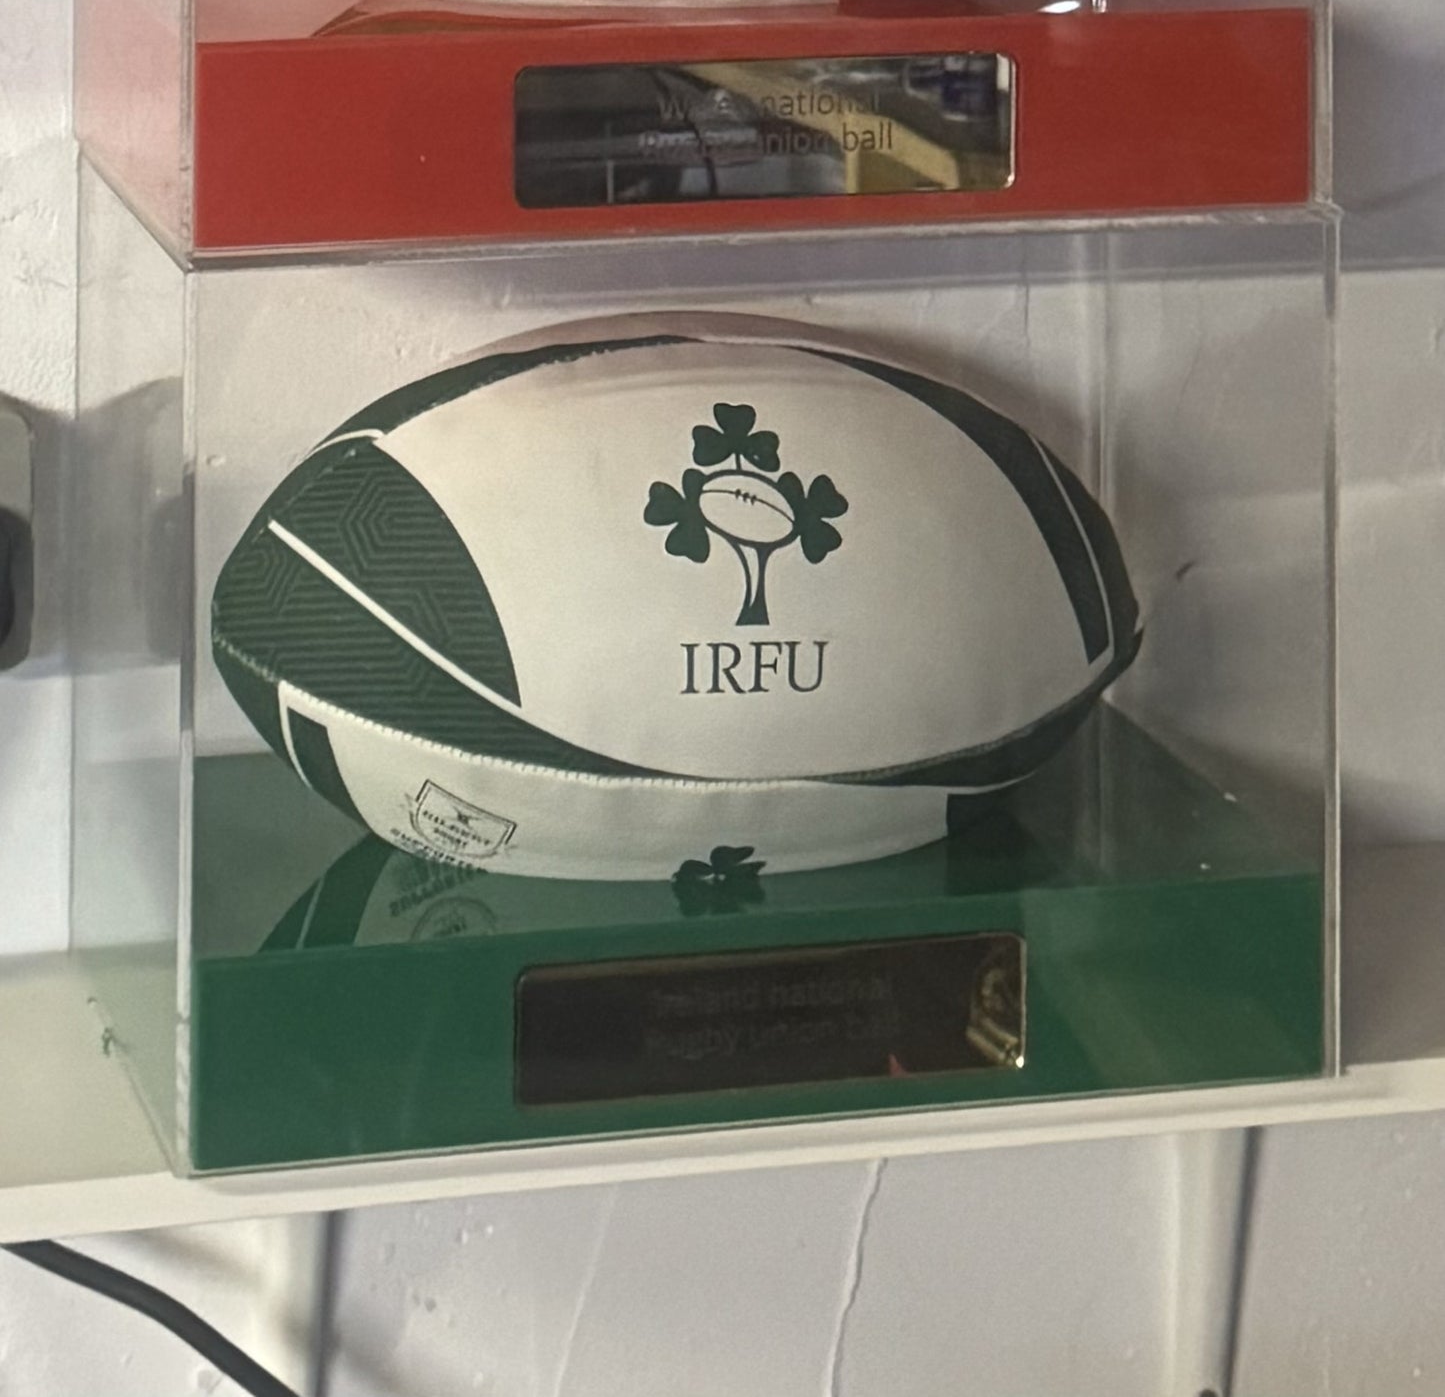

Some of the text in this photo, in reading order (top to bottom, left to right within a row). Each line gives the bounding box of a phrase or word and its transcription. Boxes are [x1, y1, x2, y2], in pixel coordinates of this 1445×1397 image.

[752, 120, 893, 154] nion ball
[680, 640, 829, 695] IRFU
